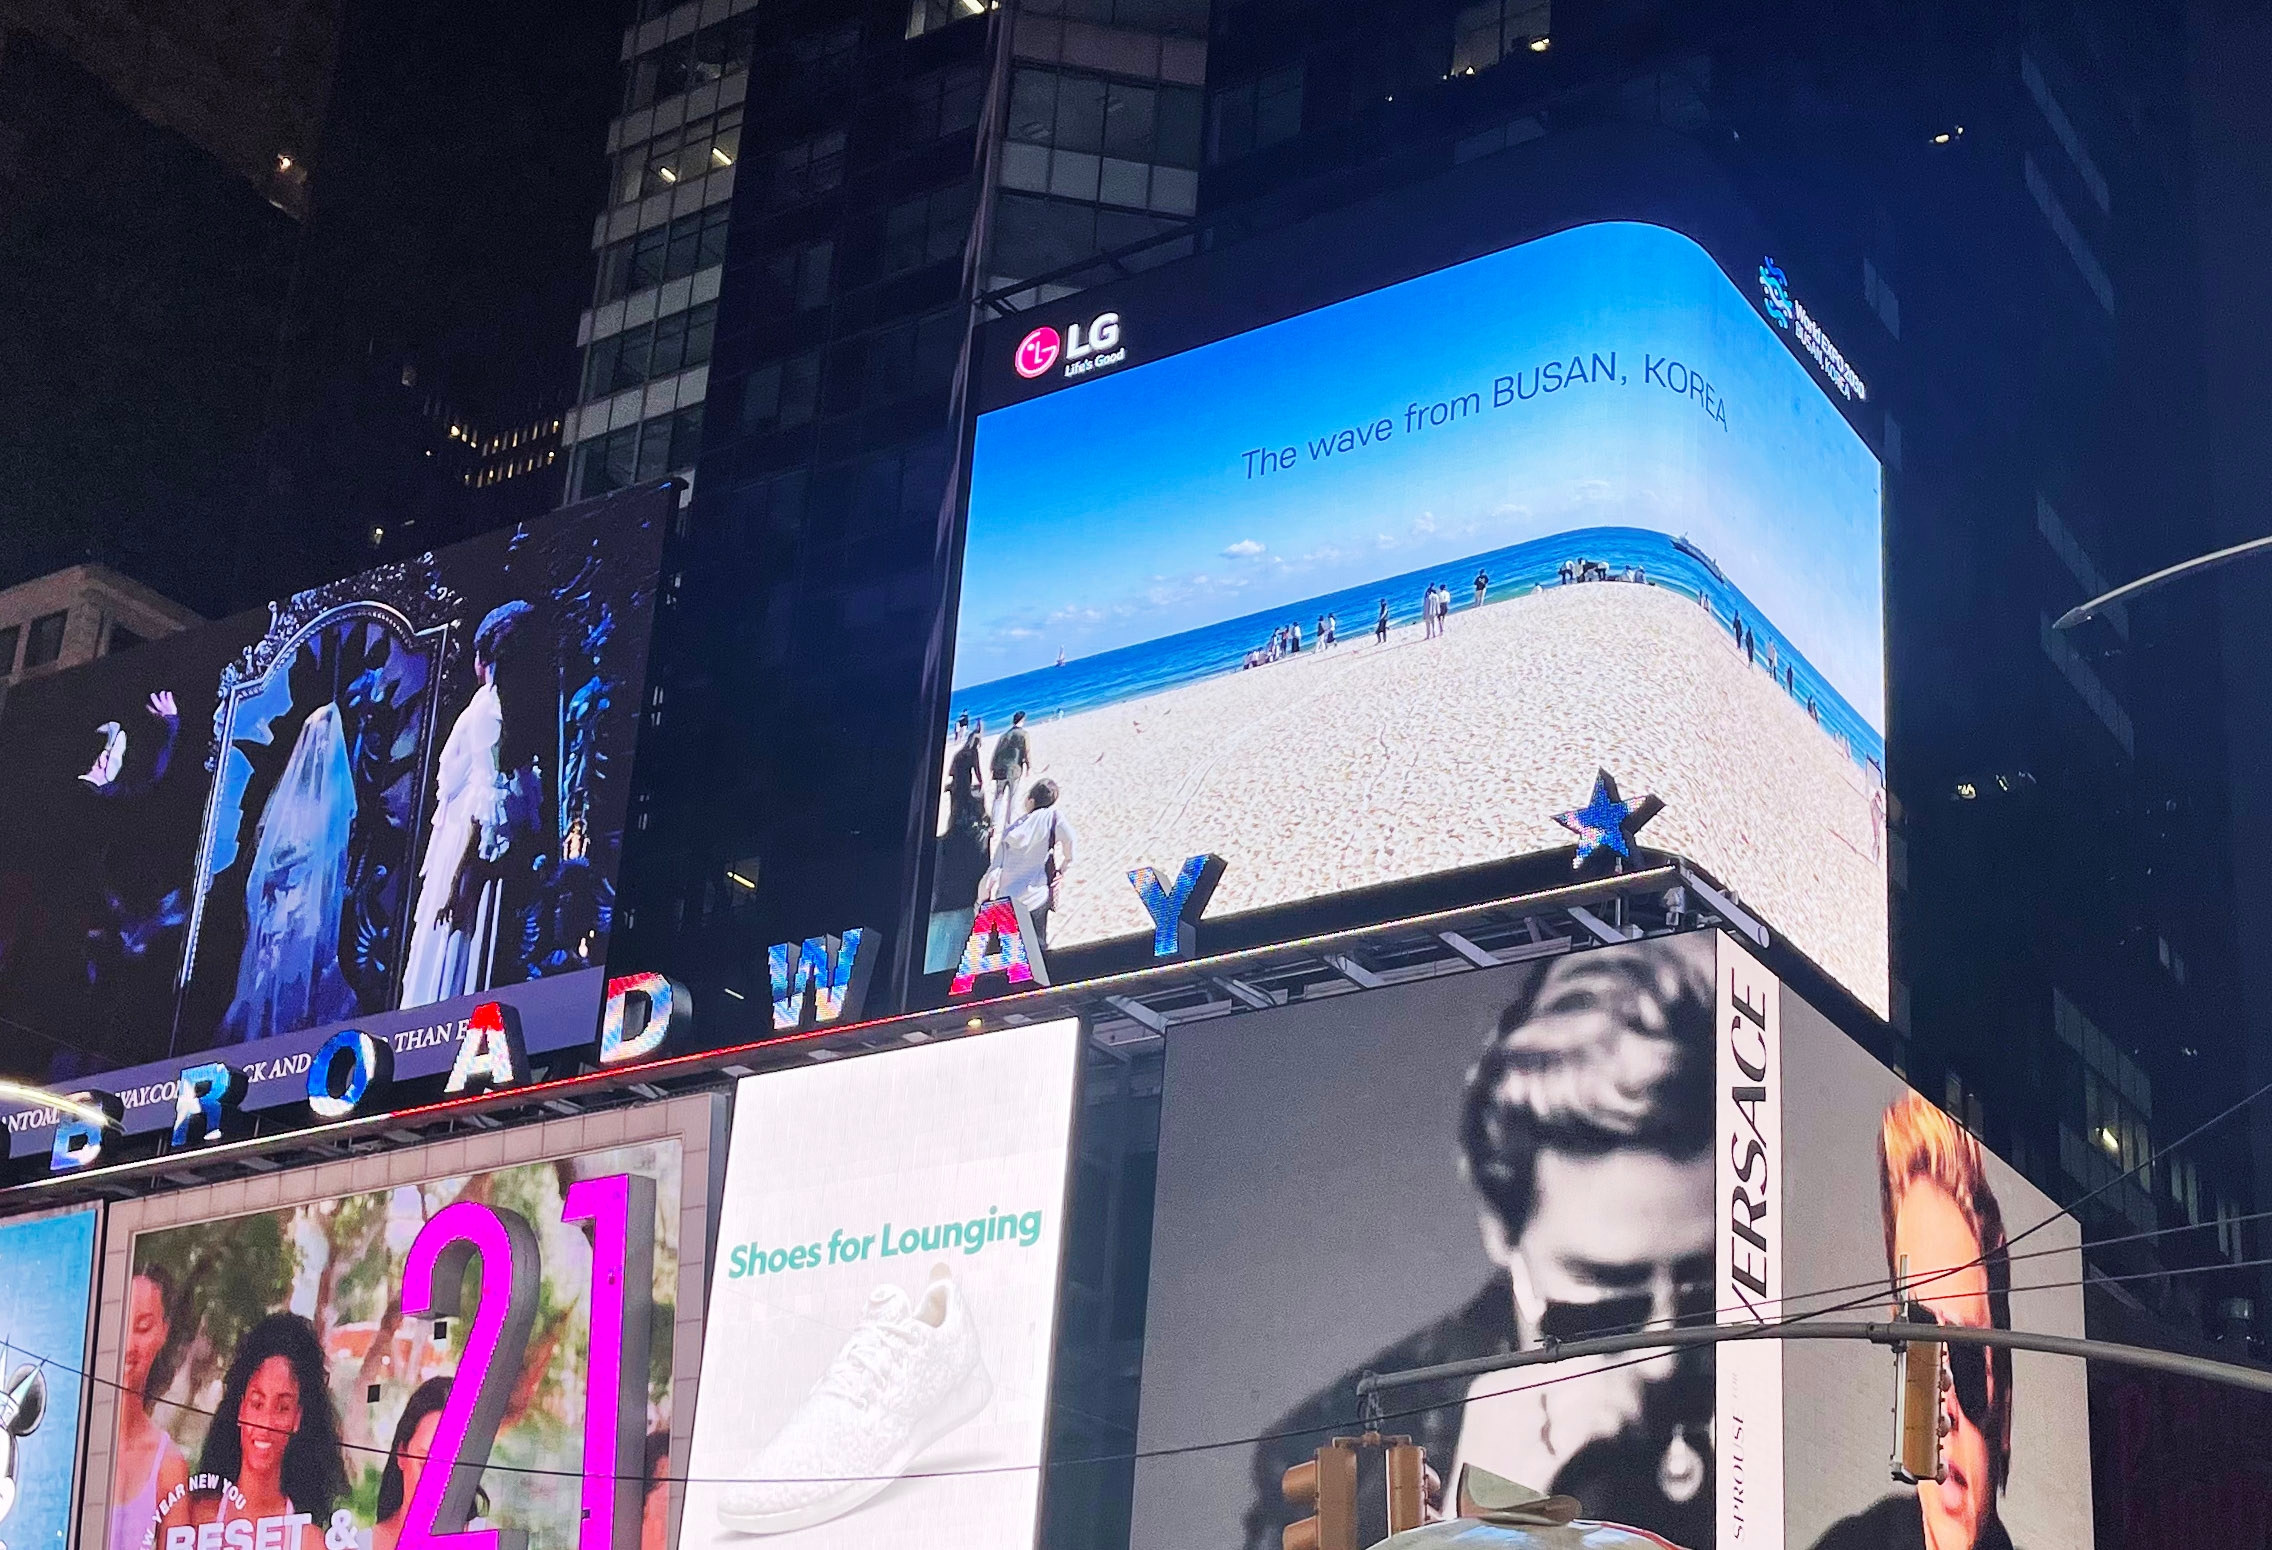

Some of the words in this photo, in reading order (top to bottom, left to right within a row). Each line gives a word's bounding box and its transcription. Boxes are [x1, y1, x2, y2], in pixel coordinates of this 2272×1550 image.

[1063, 358, 1093, 377] Life's
[1094, 347, 1126, 367] Good
[1066, 311, 1120, 360] LG
[1795, 299, 1822, 346] World
[1821, 333, 1845, 372] EXPO
[1241, 447, 1297, 480] The
[1308, 418, 1394, 461] wave
[1403, 392, 1481, 433] from
[1493, 352, 1628, 408] BUSAN,
[1645, 354, 1728, 433] KOREA
[268, 1053, 312, 1079] AND
[394, 1022, 453, 1054] THAN
[728, 1242, 823, 1279] Shoes
[827, 1228, 876, 1265] for
[880, 1205, 1043, 1258] Lounging
[396, 1174, 629, 1550] 21
[152, 1483, 186, 1523] YEAR
[189, 1473, 219, 1491] NEW
[222, 1478, 247, 1510] YOU
[325, 1508, 358, 1550] &
